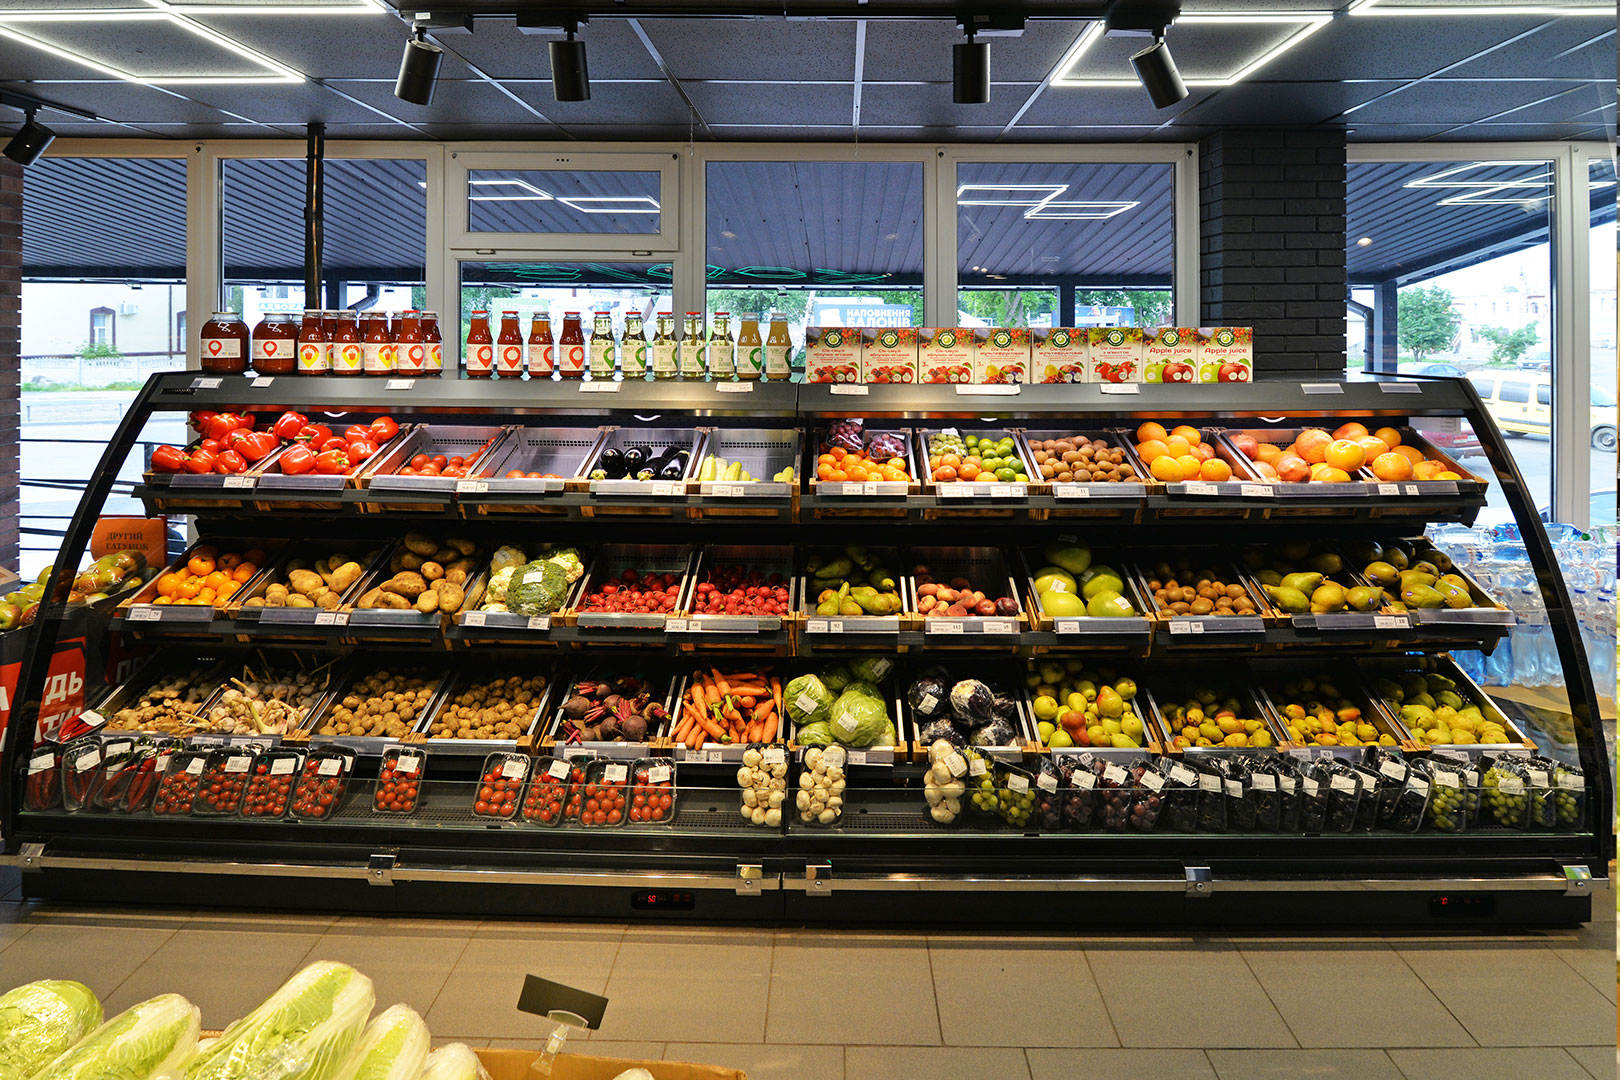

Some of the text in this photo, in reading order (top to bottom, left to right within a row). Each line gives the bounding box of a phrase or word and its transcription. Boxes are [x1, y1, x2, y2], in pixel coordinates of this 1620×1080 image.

[846, 309, 911, 317] НАПОВНЕННЯ
[846, 318, 911, 328] БАЛОНІВ
[1149, 347, 1192, 355] Apple juice
[1204, 347, 1247, 355] Apple juice
[106, 531, 144, 541] ДРУГИЙ
